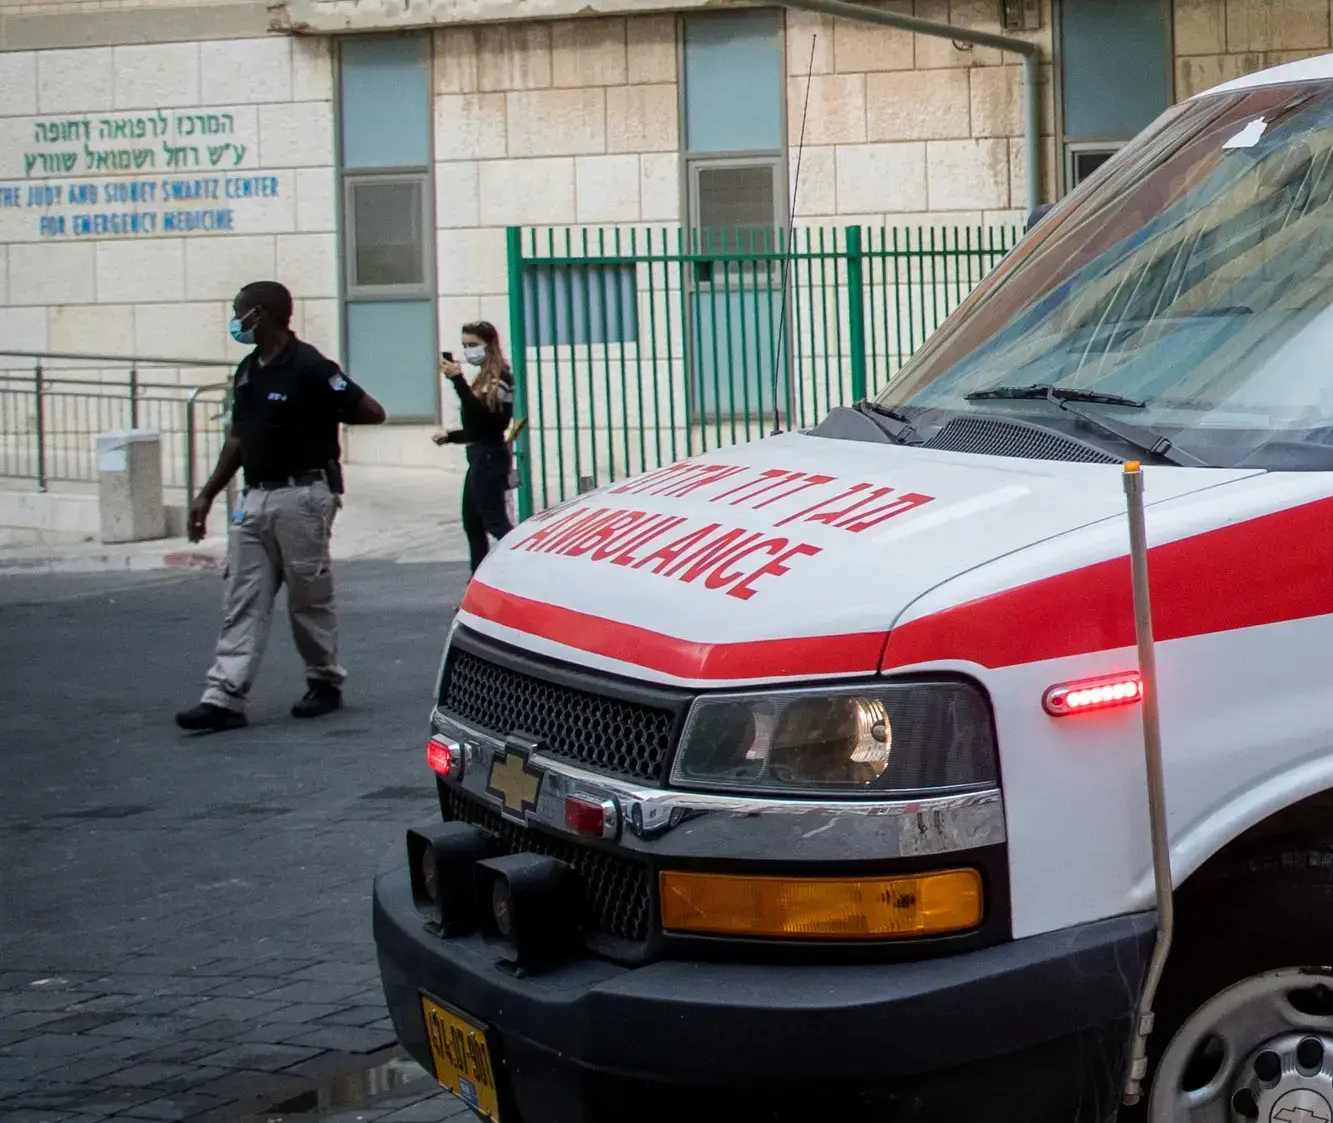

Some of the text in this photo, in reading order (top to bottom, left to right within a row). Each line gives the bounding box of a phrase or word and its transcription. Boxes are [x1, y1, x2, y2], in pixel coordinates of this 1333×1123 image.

[35, 111, 234, 143] המרכז לרפואה דחופה
[24, 151, 78, 177] שוורץ
[84, 144, 155, 171] ושמואל
[163, 141, 201, 167] רחל
[0, 176, 279, 208] THE JUDY AND SIDNEY SWARTZ CENTER
[40, 209, 234, 236] FOR EMERGENCY MEDICINE
[709, 469, 836, 509] דוד
[772, 483, 935, 533] מגן
[510, 507, 823, 600] AMBULANCE
